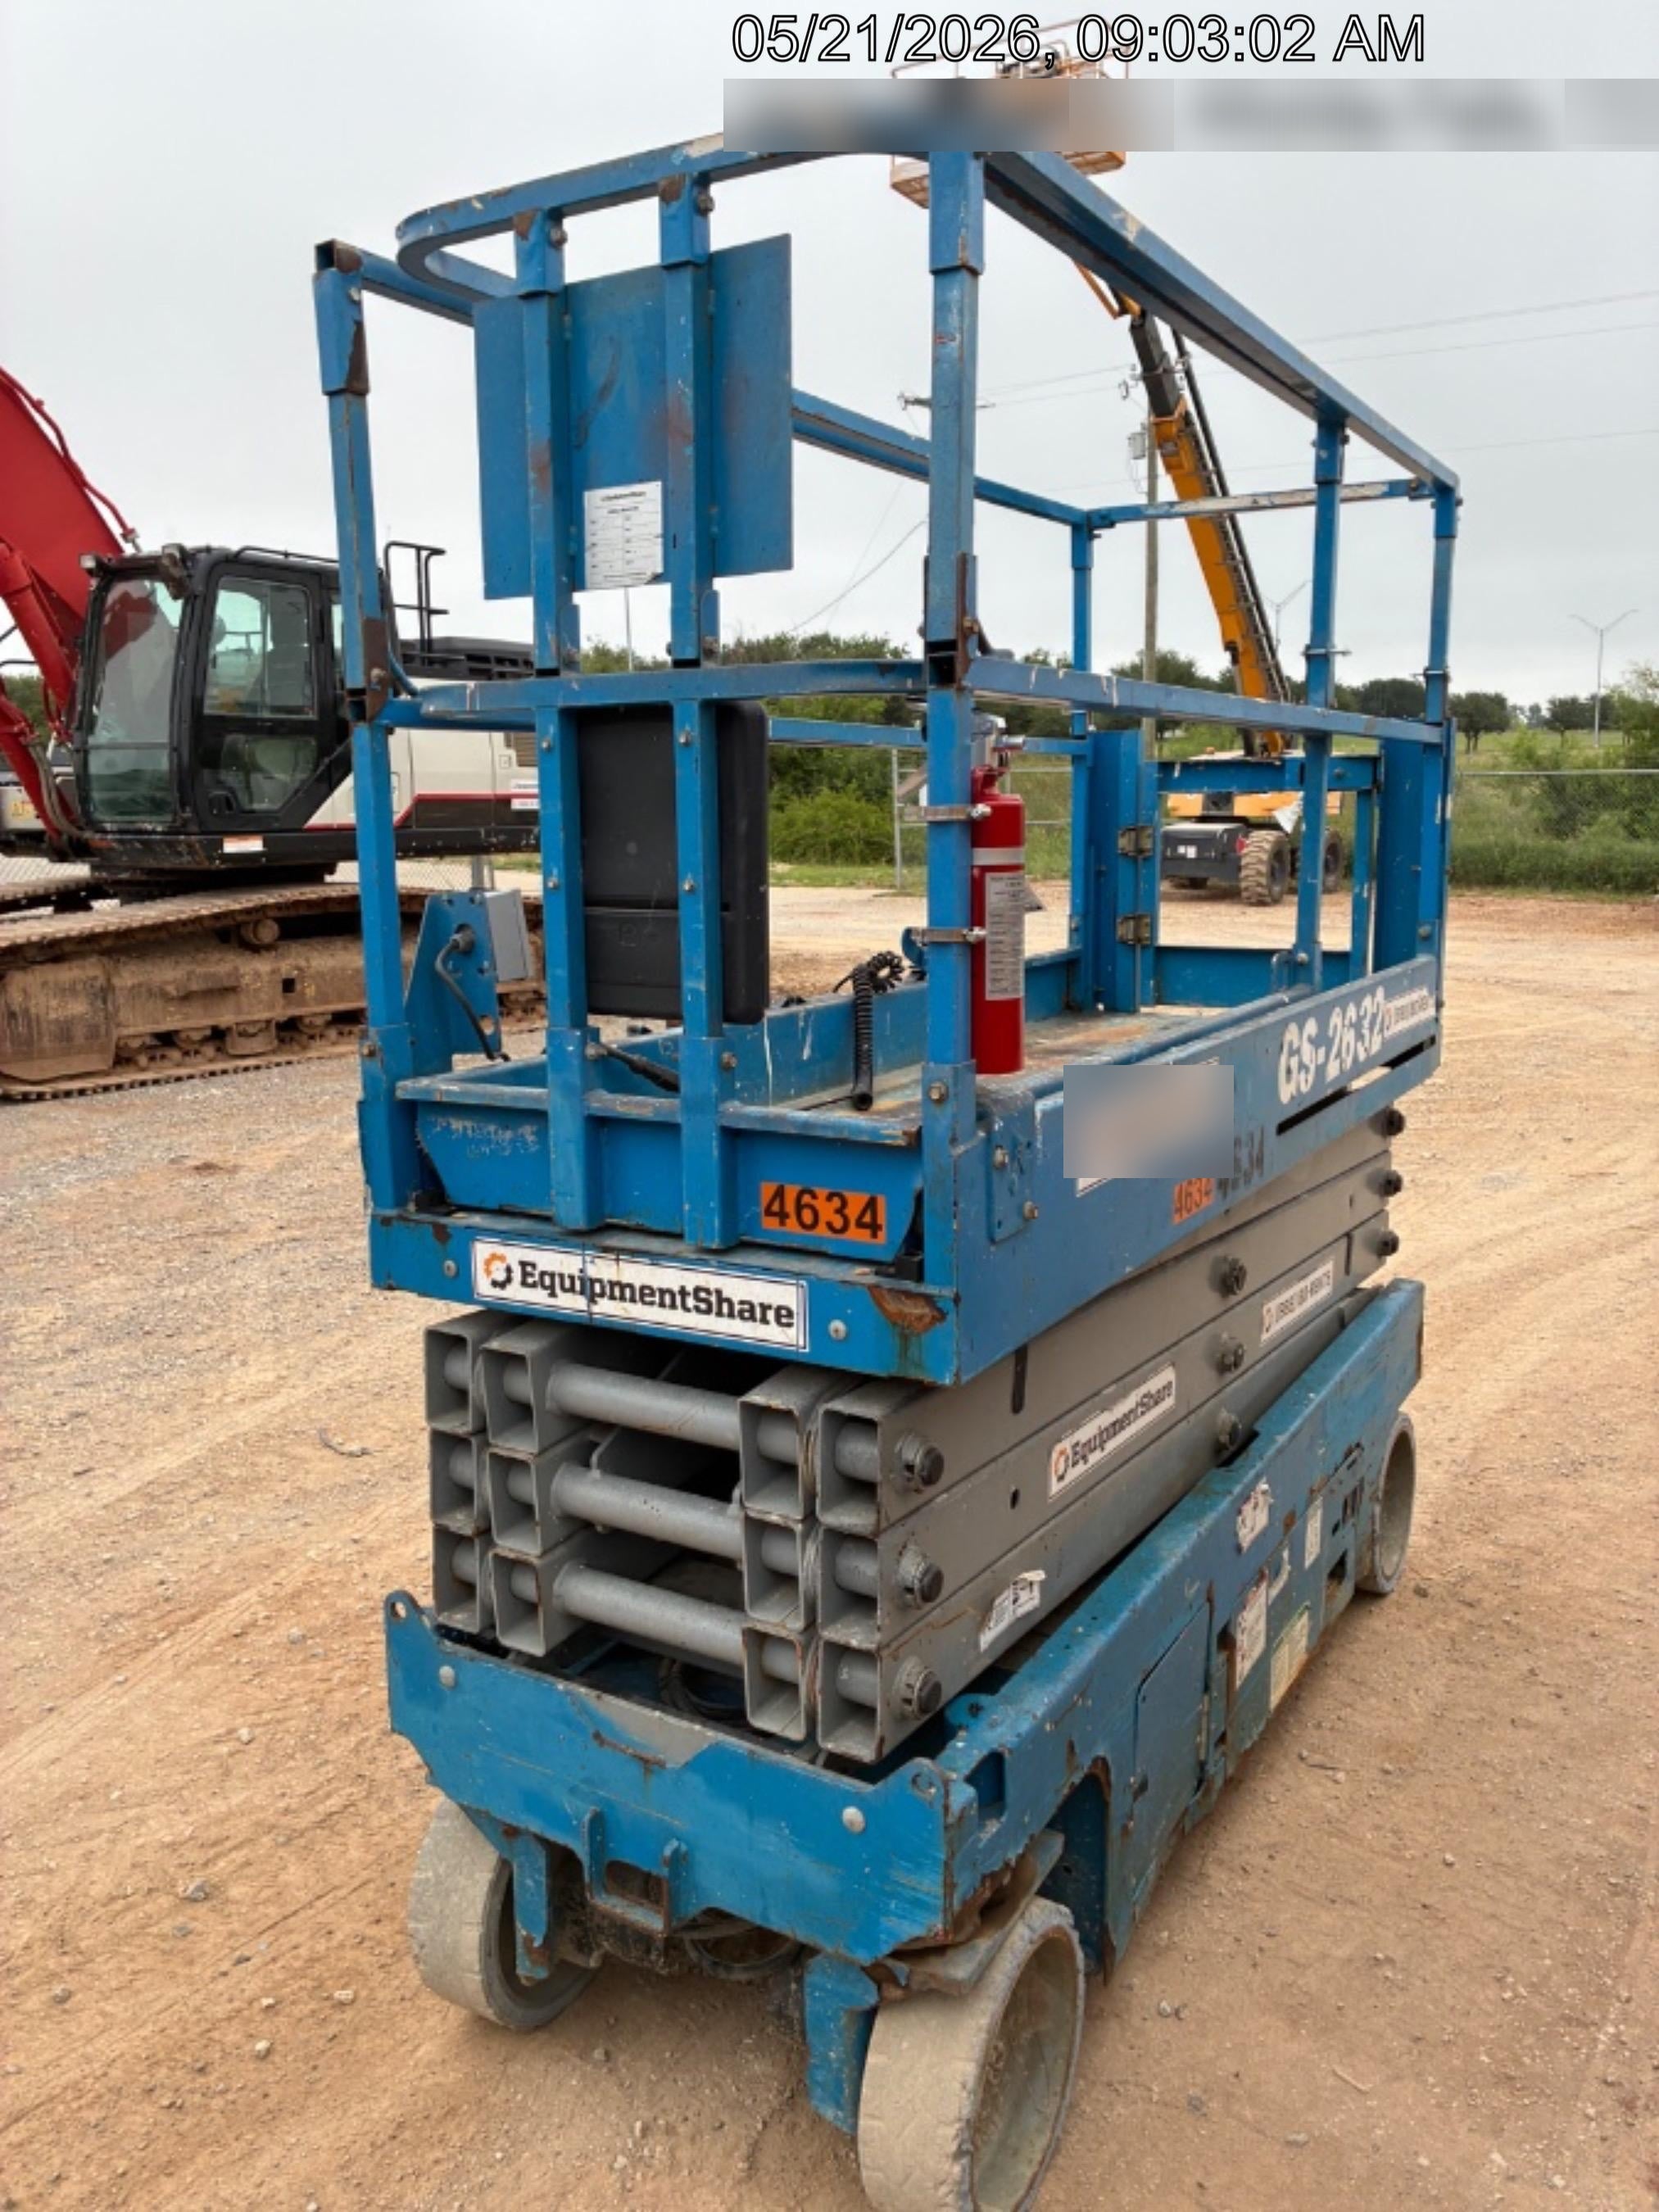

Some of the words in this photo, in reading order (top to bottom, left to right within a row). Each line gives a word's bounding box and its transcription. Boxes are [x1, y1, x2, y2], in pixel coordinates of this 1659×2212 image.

[1278, 986, 1385, 1104] GS-2632
[763, 1182, 884, 1240] 4634
[518, 1259, 796, 1328] EquipmentShare
[1071, 1380, 1174, 1467] EquipmentShare
